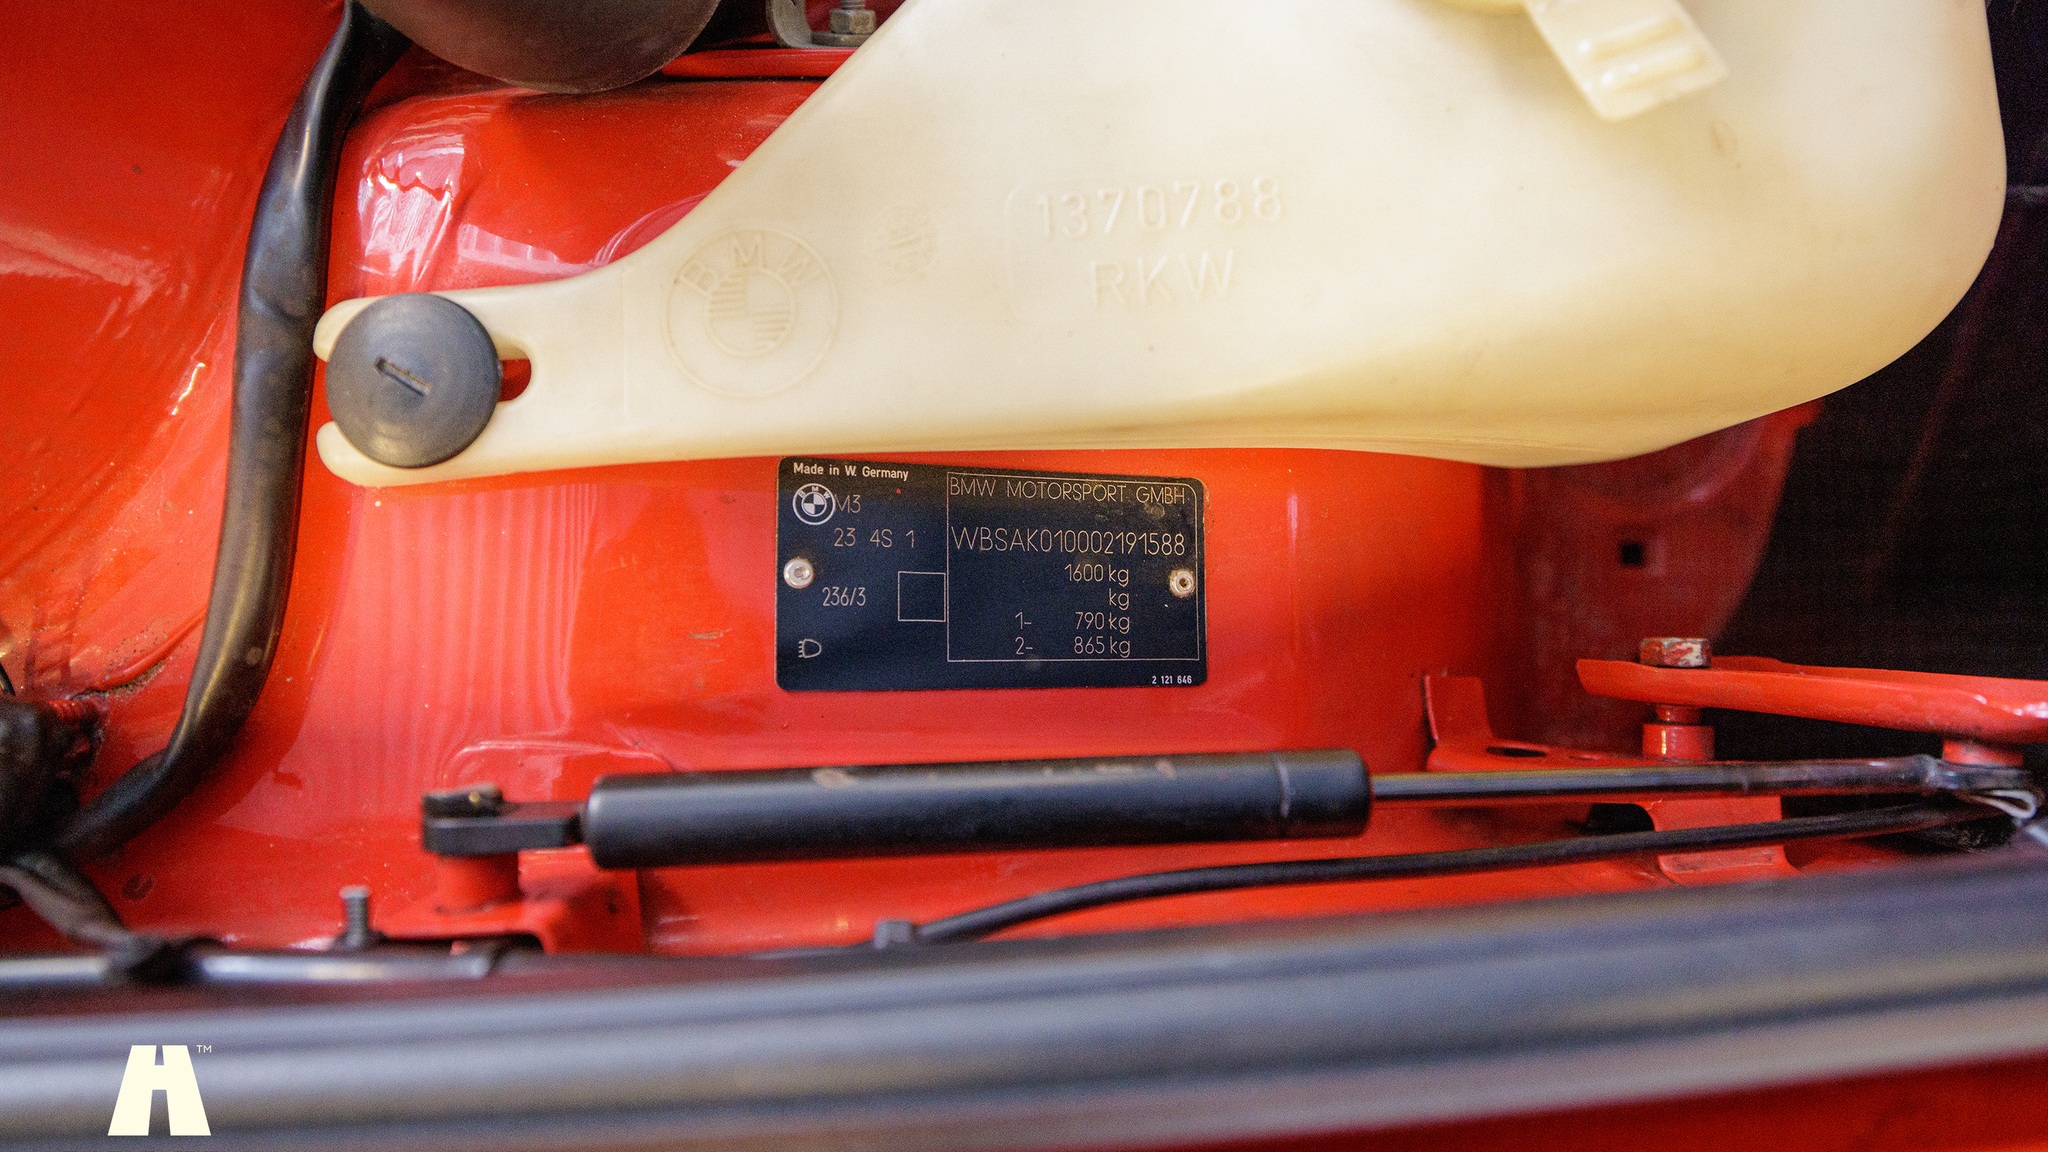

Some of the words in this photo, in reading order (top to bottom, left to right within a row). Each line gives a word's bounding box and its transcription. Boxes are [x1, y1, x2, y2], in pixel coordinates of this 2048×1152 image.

[1034, 176, 1284, 241] 1370788
[678, 233, 822, 296] BMW
[1090, 249, 1234, 307] RKW
[793, 462, 824, 475] Made
[829, 465, 840, 476] in
[862, 466, 909, 481] Germany
[798, 485, 831, 499] BMW
[950, 477, 996, 496] BMW
[1007, 480, 1127, 502] MOTORSPORT
[1136, 486, 1185, 504] GMBH
[834, 494, 861, 513] M3
[834, 527, 856, 547] 23
[869, 529, 893, 548] 4S
[905, 529, 915, 548] 1
[951, 526, 1185, 556] WBSAK010002191588
[1064, 563, 1104, 582] 1600
[1108, 564, 1129, 587] kg
[822, 586, 866, 607] 236/3
[1108, 588, 1130, 610] kg
[1015, 611, 1032, 630] 1-
[1075, 611, 1105, 630] 790
[1108, 612, 1130, 634] kg
[1015, 636, 1033, 655] 2-
[1074, 636, 1105, 654] 865
[1109, 636, 1131, 658] kg
[1152, 675, 1157, 685] 2
[1160, 675, 1173, 685] 121
[1177, 675, 1192, 685] 646
